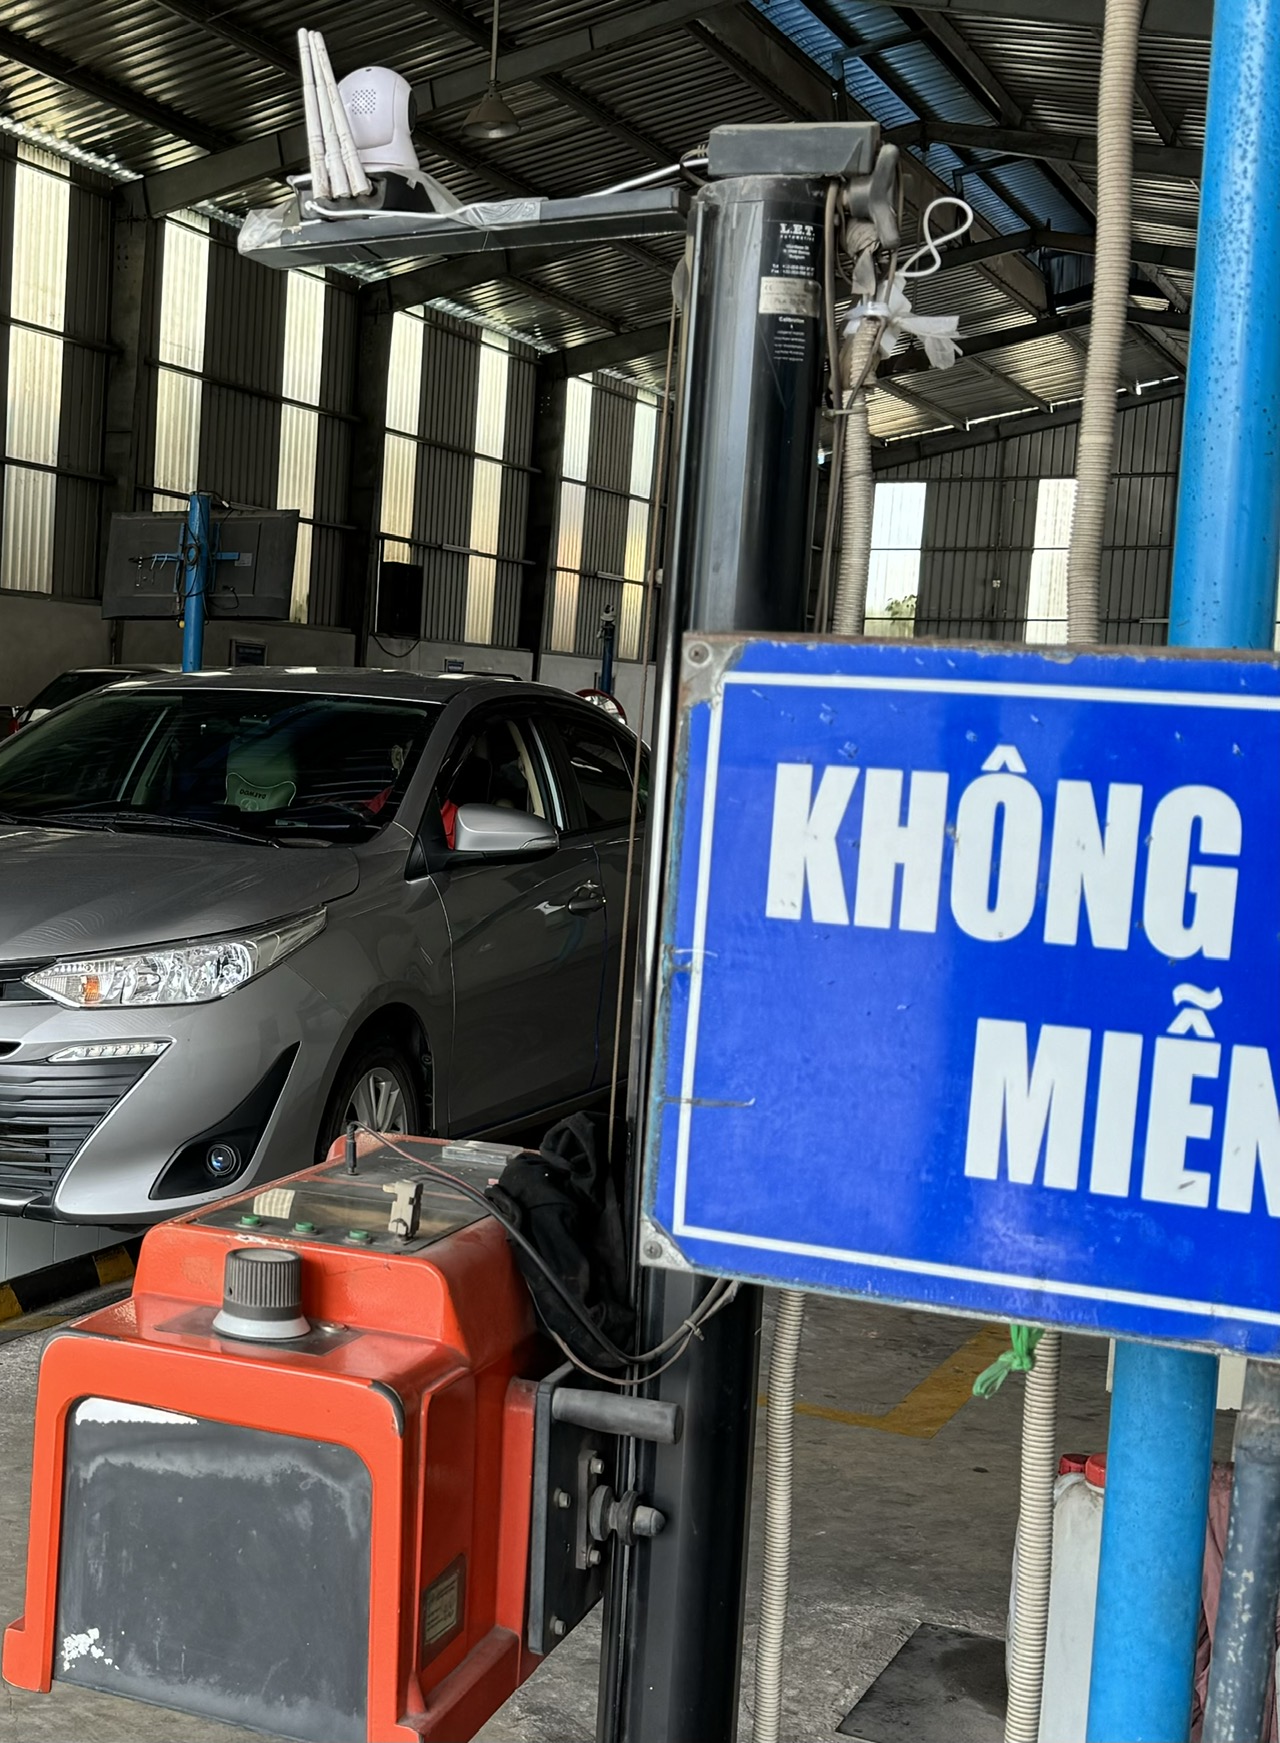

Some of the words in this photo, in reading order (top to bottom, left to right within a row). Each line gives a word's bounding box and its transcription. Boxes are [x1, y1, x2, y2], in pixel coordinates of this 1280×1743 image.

[780, 223, 815, 236] L.E.T.
[765, 745, 1243, 961] KHÔNG
[964, 983, 1280, 1218] MIỄN
